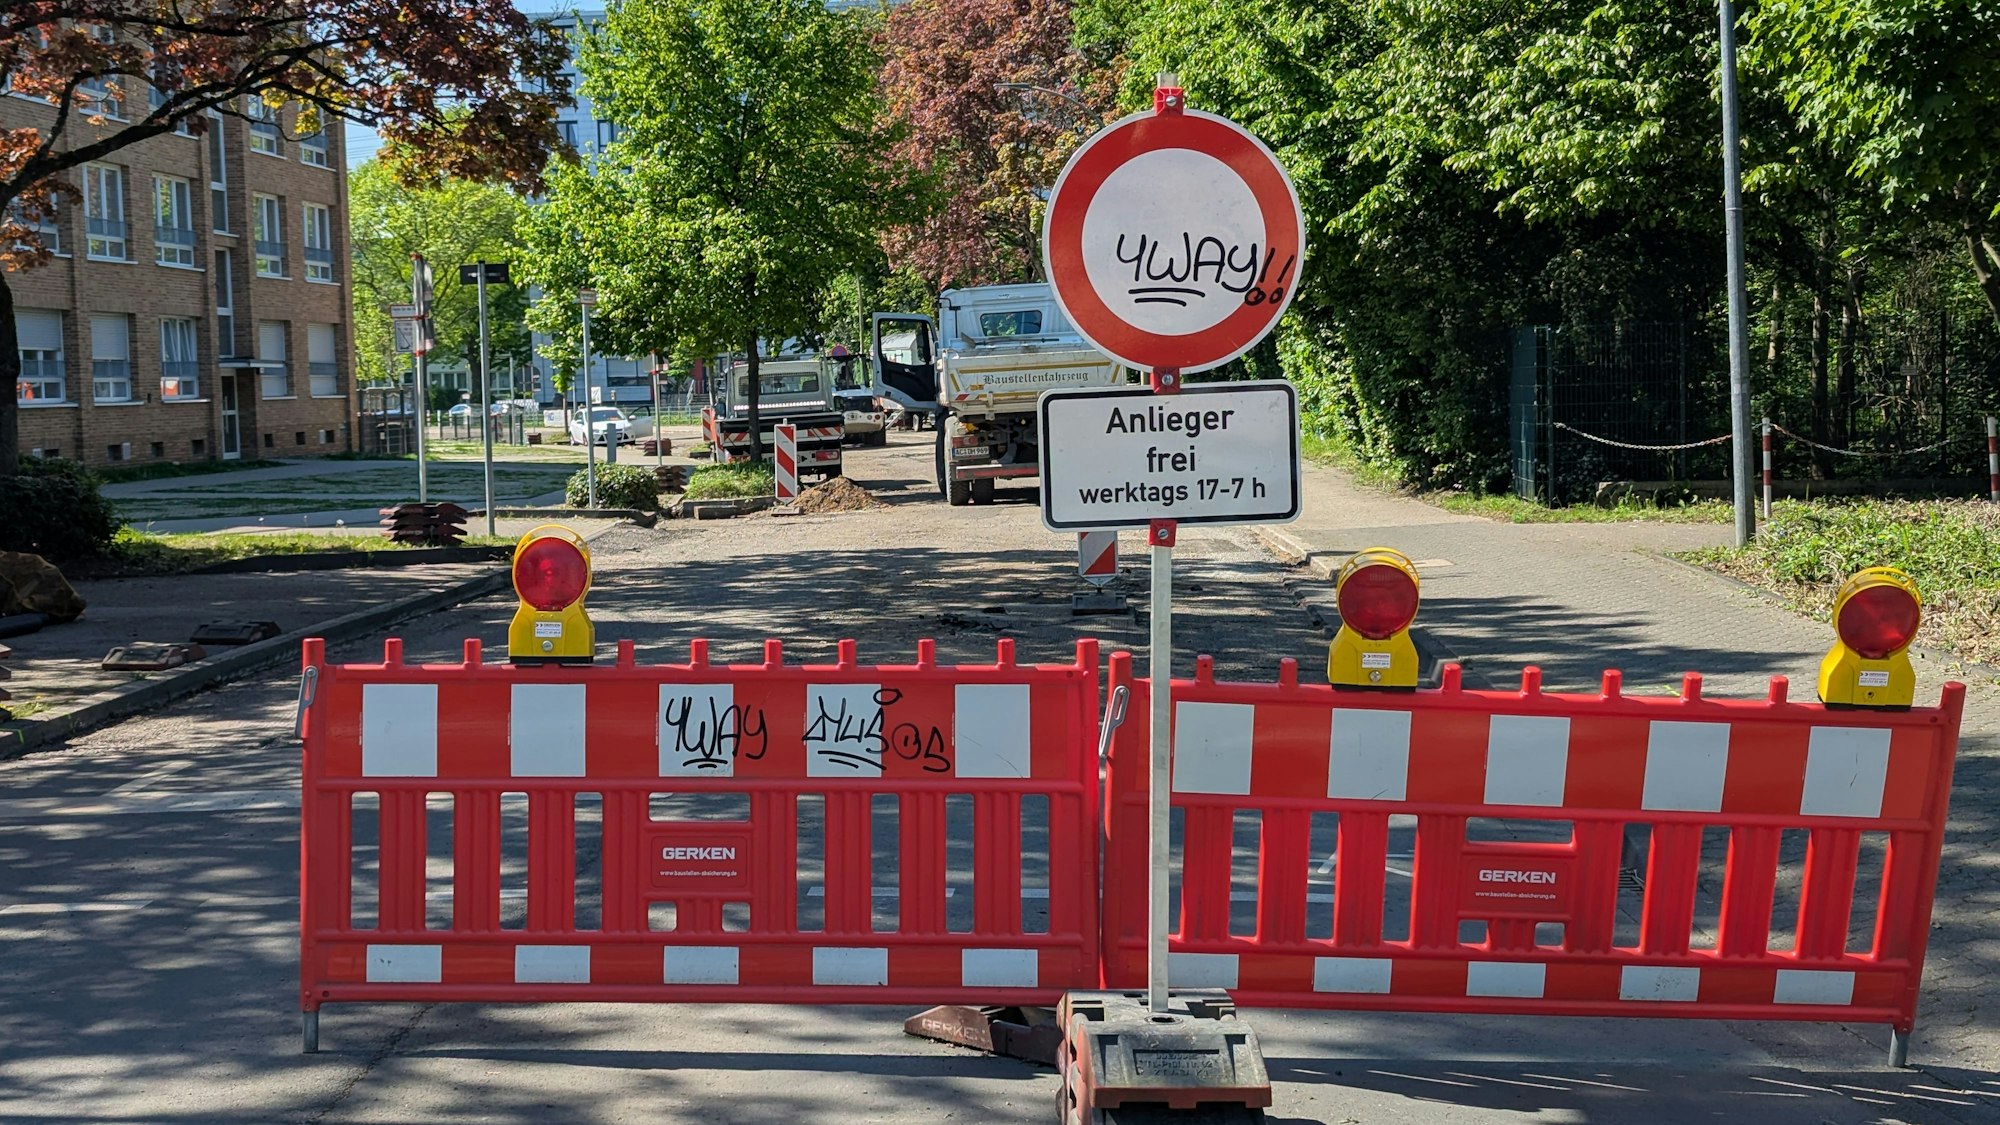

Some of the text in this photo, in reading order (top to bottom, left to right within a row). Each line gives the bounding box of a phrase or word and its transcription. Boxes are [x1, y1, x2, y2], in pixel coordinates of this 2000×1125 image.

[983, 372, 1089, 385] Baustellenfahrzeug
[1105, 406, 1235, 438] Anlieger
[1146, 445, 1196, 473] frei
[1079, 477, 1266, 507] werktags 17-7 h
[662, 847, 736, 860] GERKEN
[659, 869, 738, 877] www.baustellen-absicherung.de
[1478, 869, 1556, 884] GERKEN
